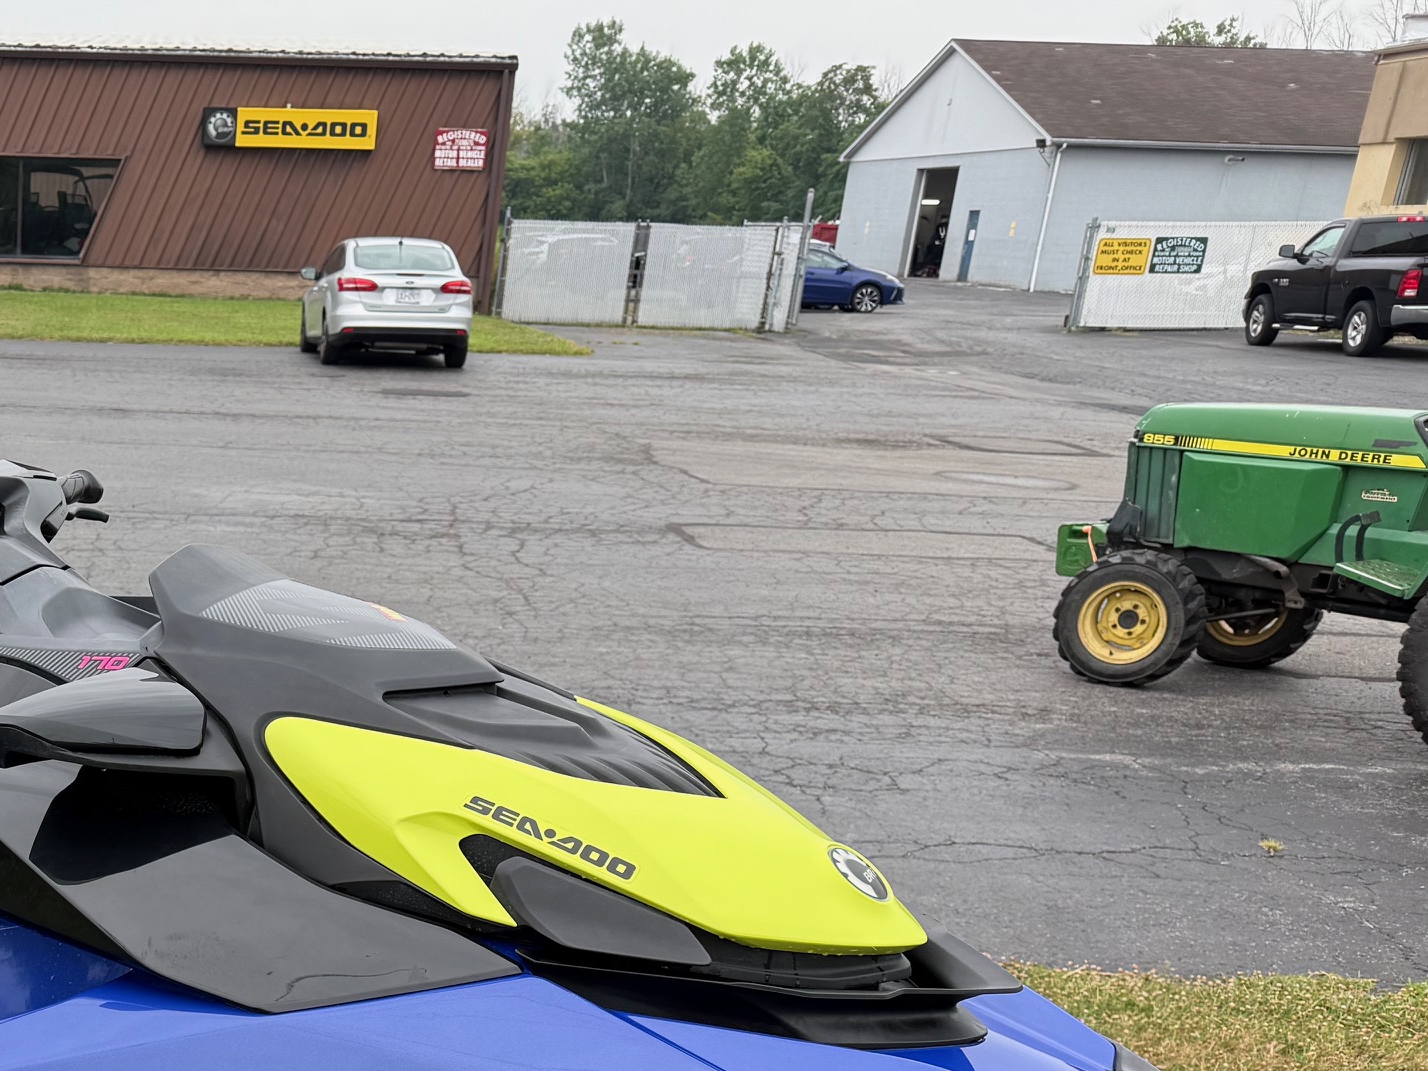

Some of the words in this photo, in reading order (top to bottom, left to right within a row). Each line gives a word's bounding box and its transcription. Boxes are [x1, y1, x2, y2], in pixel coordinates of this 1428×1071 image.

[437, 130, 487, 144] REGISTERED
[1156, 237, 1205, 251] REGISTERED
[1143, 433, 1176, 446] 855
[1289, 447, 1331, 460] JOHN
[1337, 452, 1393, 465] DEERE
[77, 655, 130, 671] 170
